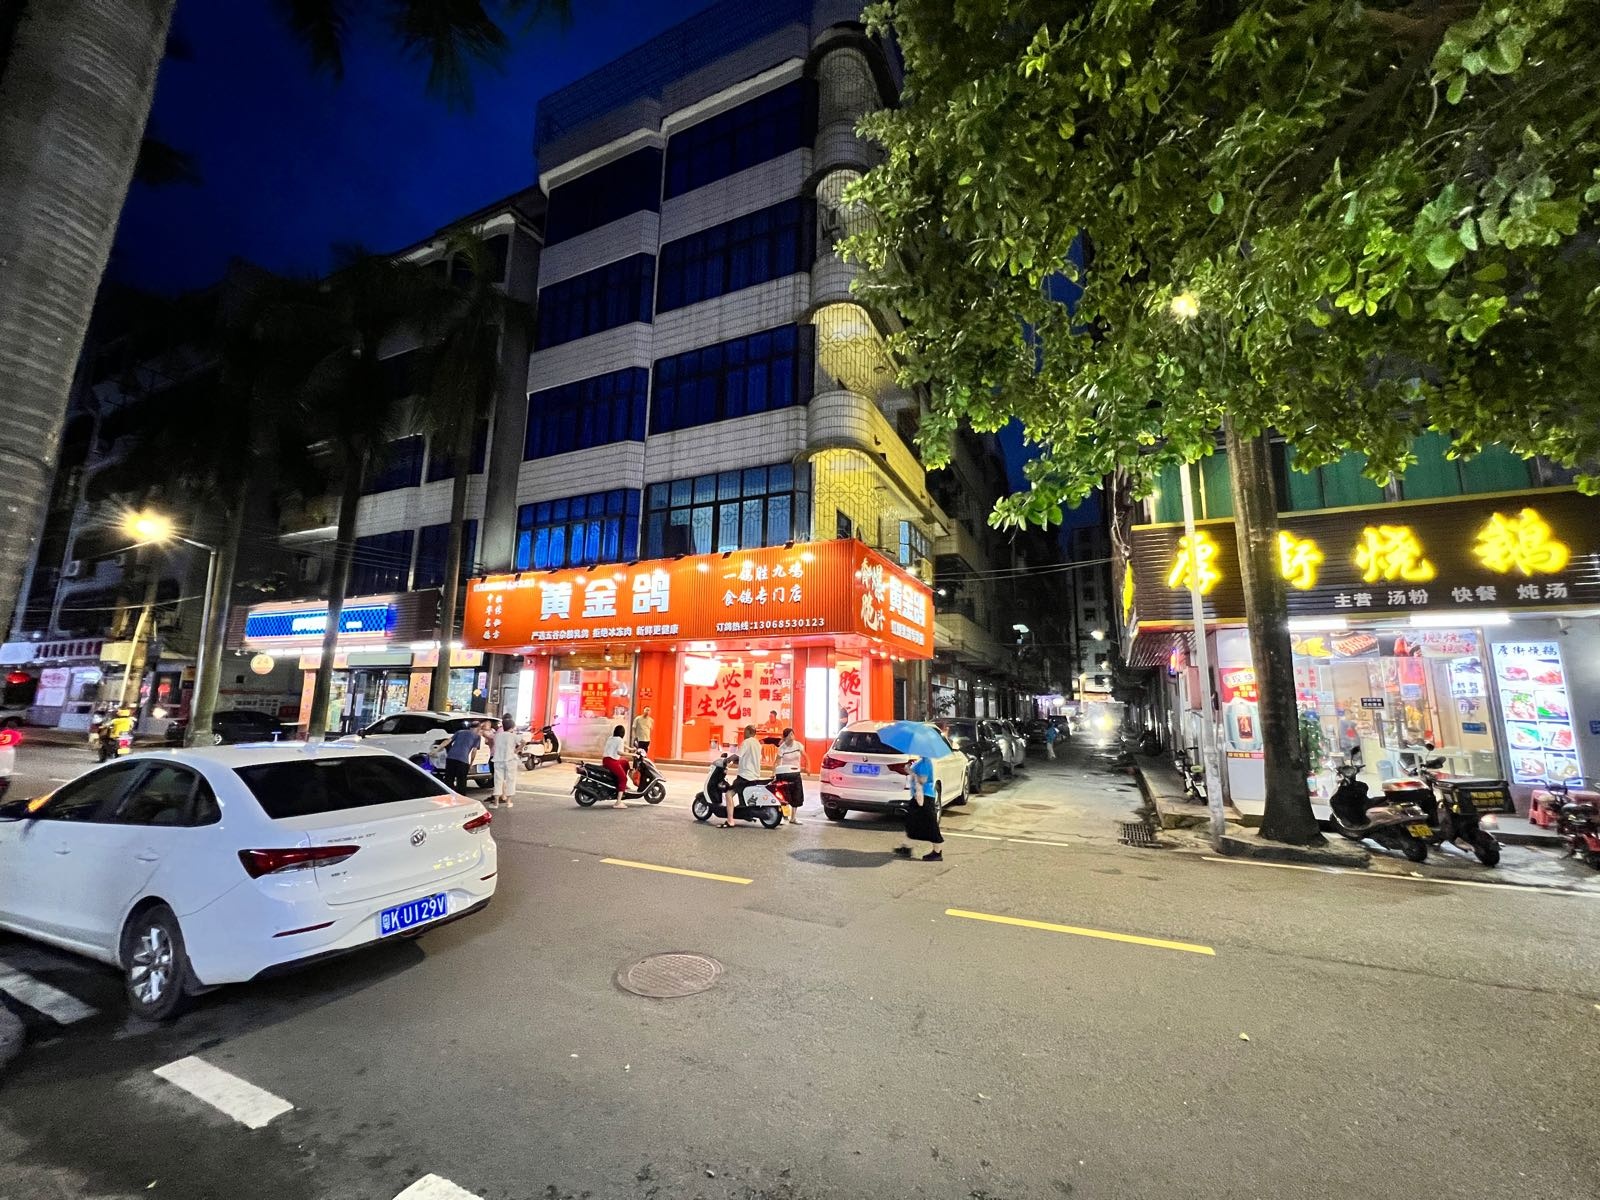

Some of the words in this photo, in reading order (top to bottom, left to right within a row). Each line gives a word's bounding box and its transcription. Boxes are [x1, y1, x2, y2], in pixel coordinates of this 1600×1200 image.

[540, 570, 670, 621] 黄金鸽
[723, 584, 802, 606] 食鸽专门店
[1334, 593, 1373, 609] 主营
[1388, 589, 1429, 605] 汤粉
[1451, 585, 1497, 602] 快餐
[1517, 582, 1569, 600] 炖汤
